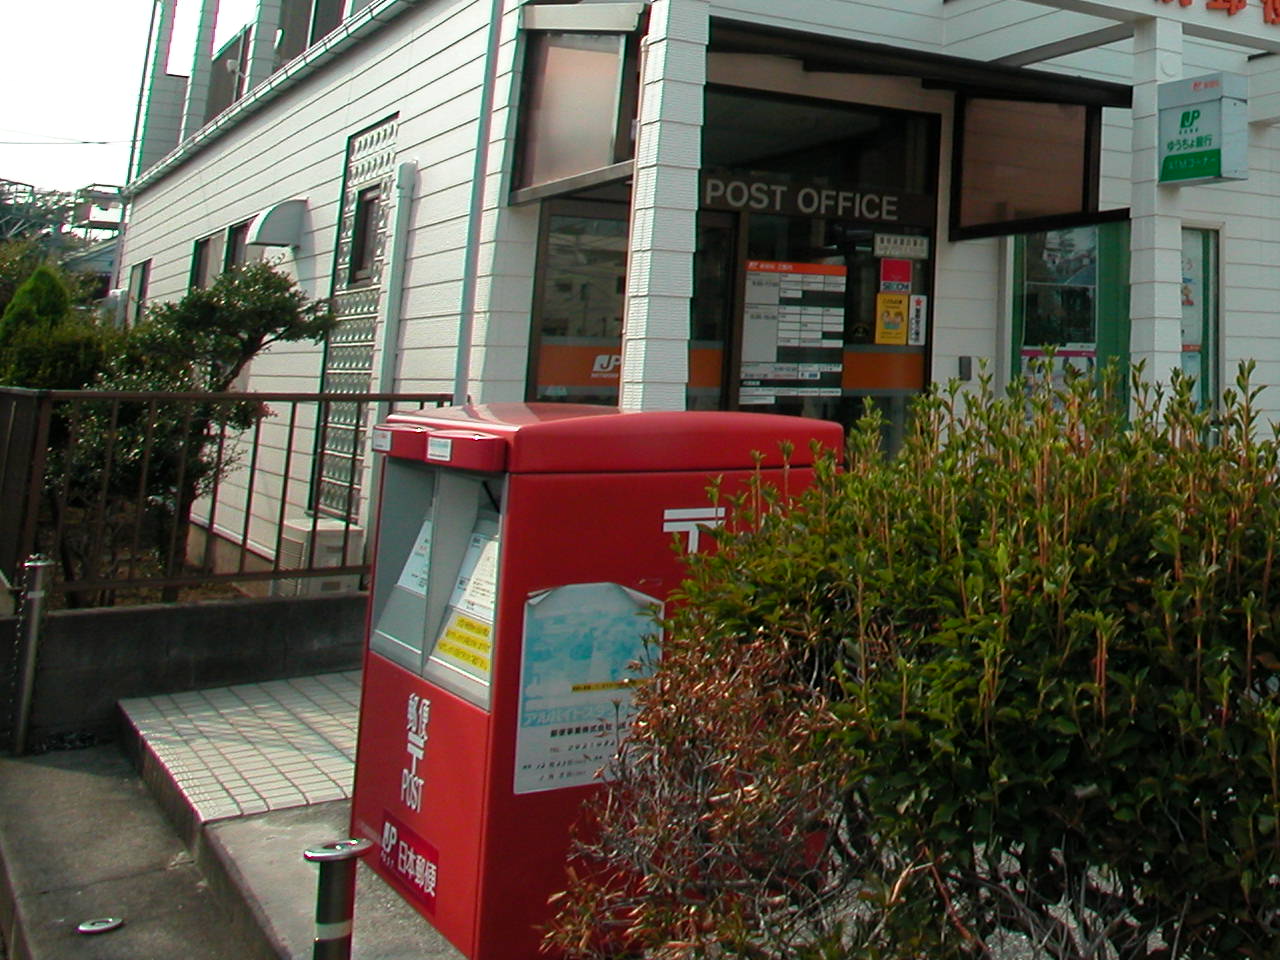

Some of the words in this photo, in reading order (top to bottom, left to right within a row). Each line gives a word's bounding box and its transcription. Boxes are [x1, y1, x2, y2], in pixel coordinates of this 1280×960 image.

[1167, 134, 1213, 152] ゆうちょ銀行
[705, 178, 788, 211] POST
[797, 188, 899, 221] OFFICE
[407, 693, 431, 740] 郵便
[401, 768, 424, 813] POST
[398, 840, 438, 897] 日本郵便
